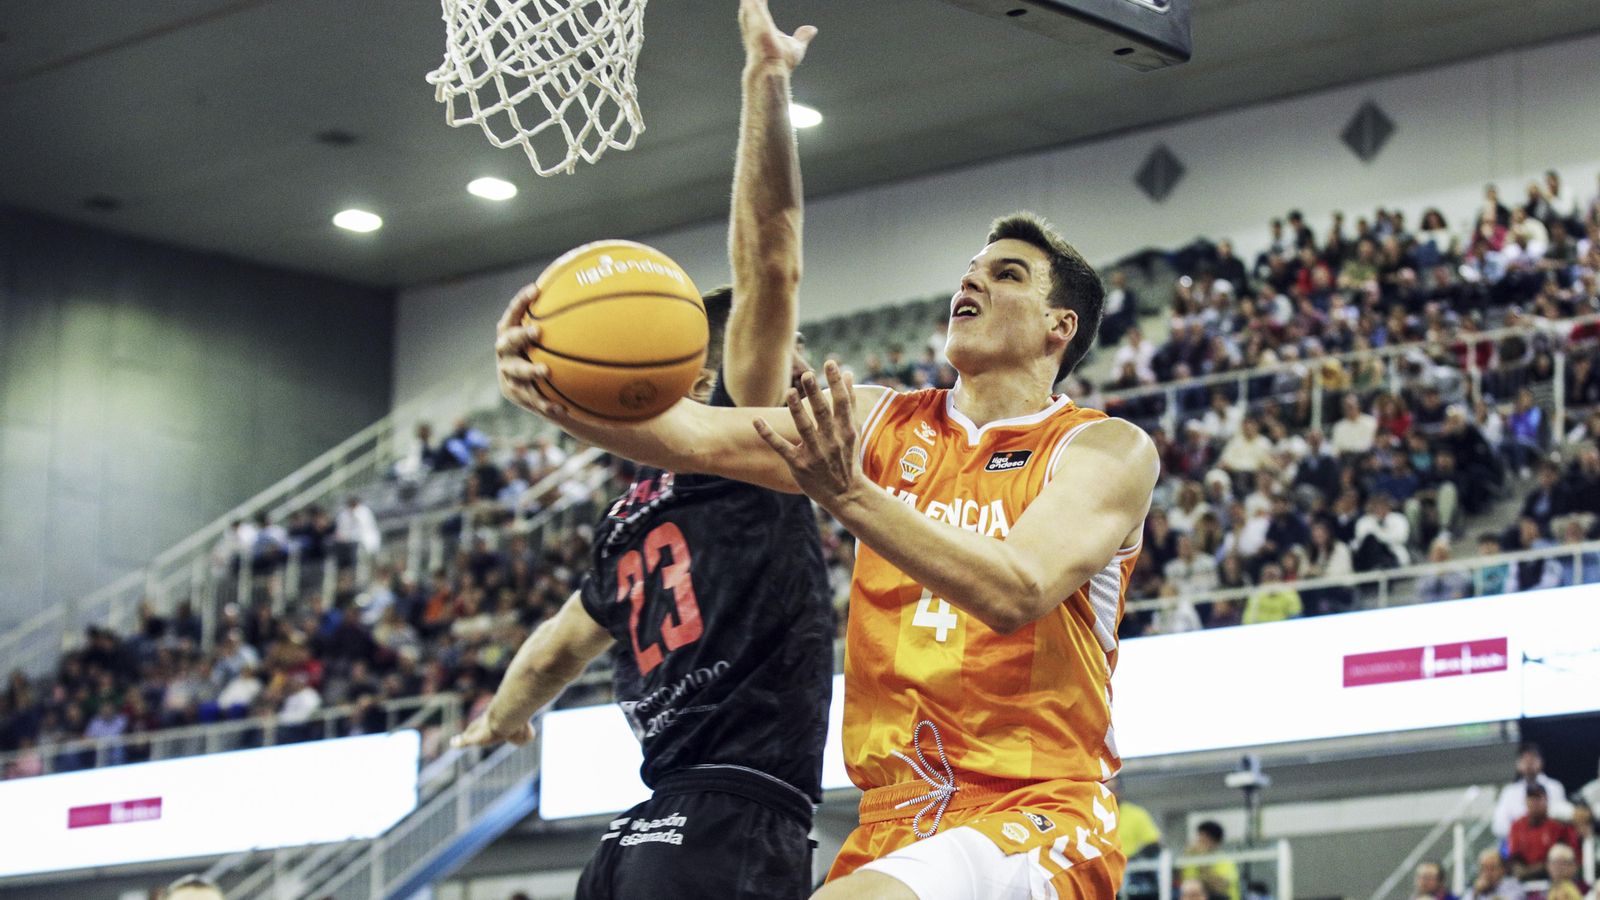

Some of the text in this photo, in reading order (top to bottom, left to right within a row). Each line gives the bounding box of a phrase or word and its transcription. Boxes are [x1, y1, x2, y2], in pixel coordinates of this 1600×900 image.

[988, 460, 1025, 470] endesa
[992, 456, 1009, 465] liga
[616, 521, 704, 678] 23
[911, 586, 958, 642] 4
